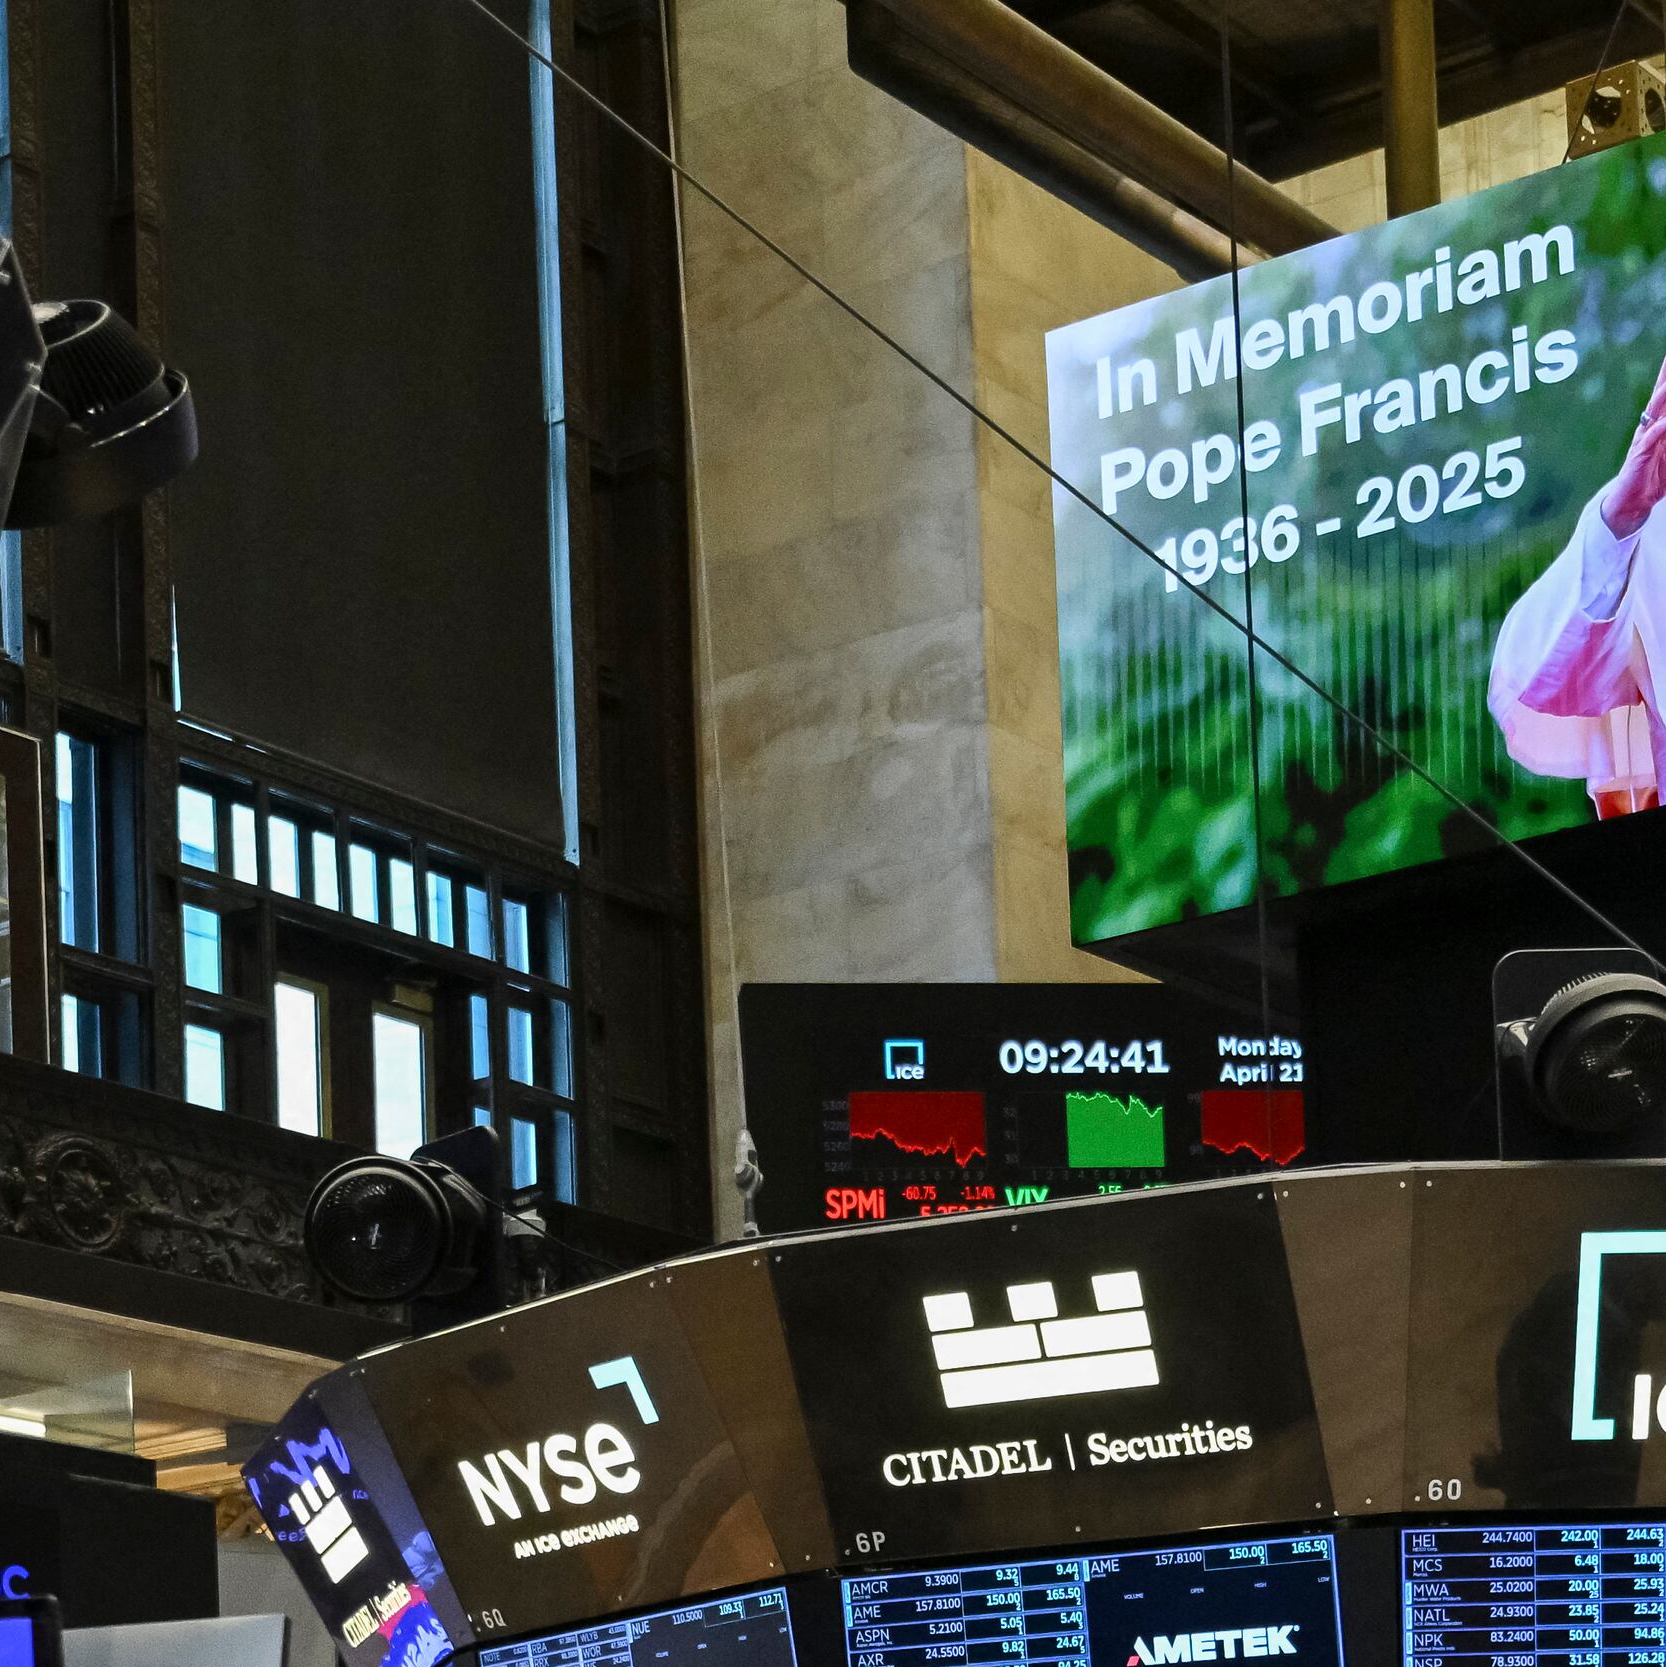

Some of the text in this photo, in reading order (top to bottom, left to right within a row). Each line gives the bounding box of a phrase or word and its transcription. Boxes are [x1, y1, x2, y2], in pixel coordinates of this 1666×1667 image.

[1095, 225, 1576, 422] In Memoriam
[1099, 320, 1580, 516] Pope Francis
[1156, 436, 1526, 593] 1936 2025
[999, 1039, 1170, 1075] 09:24:41
[1218, 1035, 1302, 1059] Monday
[1220, 1063, 1268, 1086] April
[826, 1188, 886, 1220] SPMi
[901, 1186, 937, 1201] -60.75
[960, 1185, 995, 1200] -1.14%
[882, 1420, 1252, 1487] CITADEL Securities
[855, 1530, 886, 1553] 6P
[1412, 1531, 1533, 1547] HEI 244.7400
[1090, 1552, 1202, 1574] AME 157.8100
[851, 1574, 959, 1595] AMCR 9.3900
[1123, 1592, 1144, 1600] VOLUME
[1413, 1581, 1533, 1596] MWA 25.0200
[482, 1608, 508, 1630] 6Q
[633, 1609, 703, 1635] NUE 110.5000
[855, 1622, 963, 1643] ASPN 5.2100
[1414, 1631, 1534, 1646] NPK 83.2400
[1126, 1625, 1298, 1667] AMETEK
